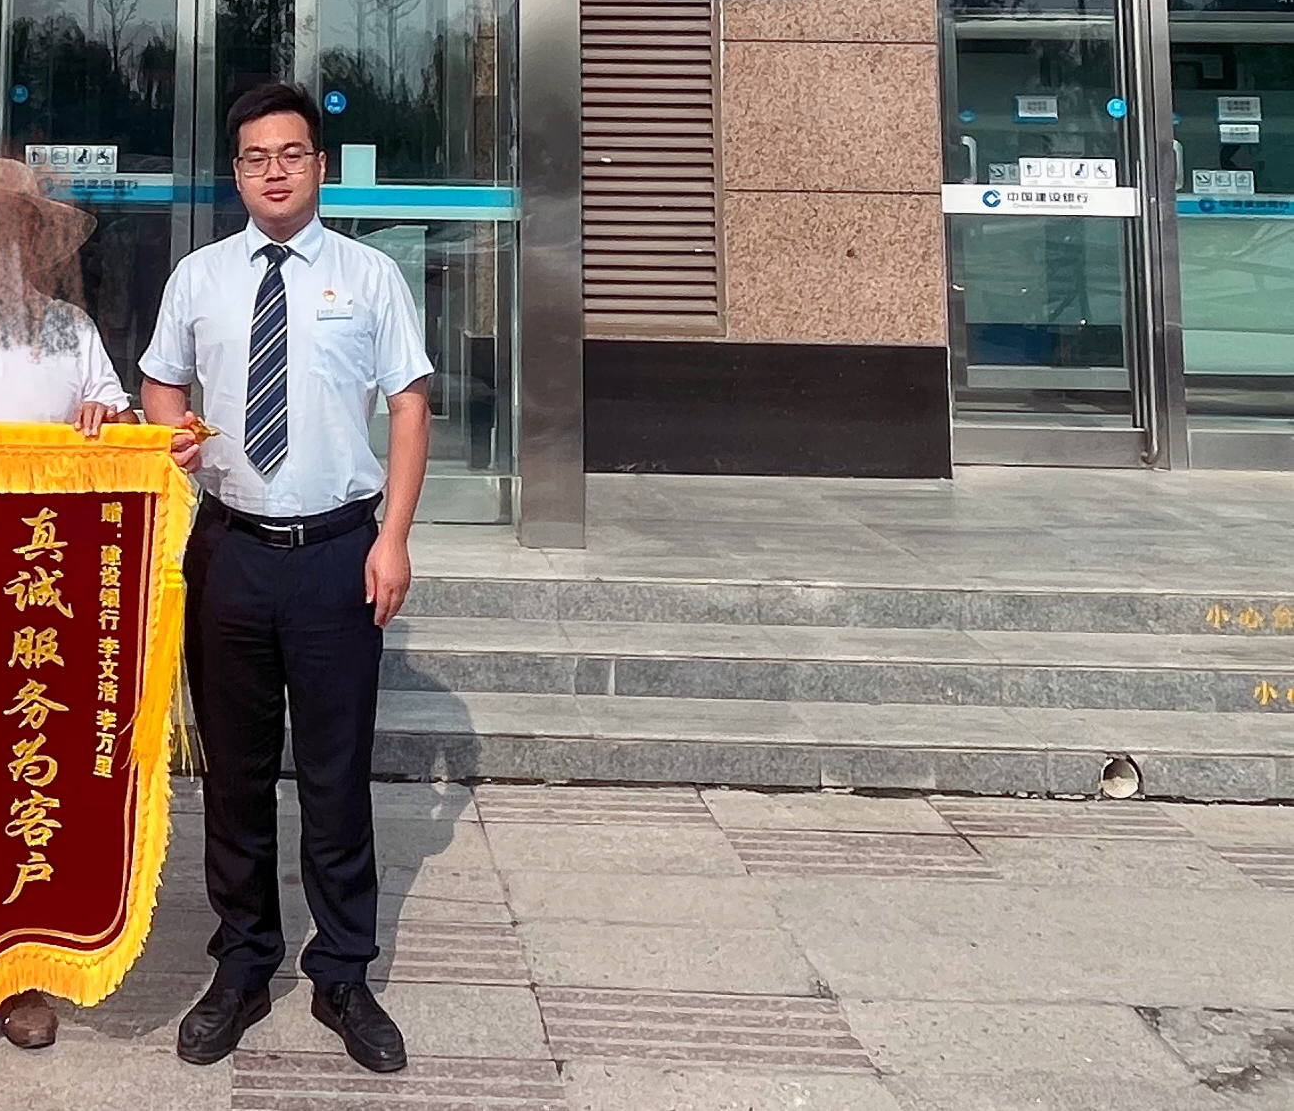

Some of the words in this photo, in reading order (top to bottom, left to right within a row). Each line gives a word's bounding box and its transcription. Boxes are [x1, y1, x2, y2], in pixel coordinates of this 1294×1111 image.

[2, 507, 74, 906] 真诚服务为客户
